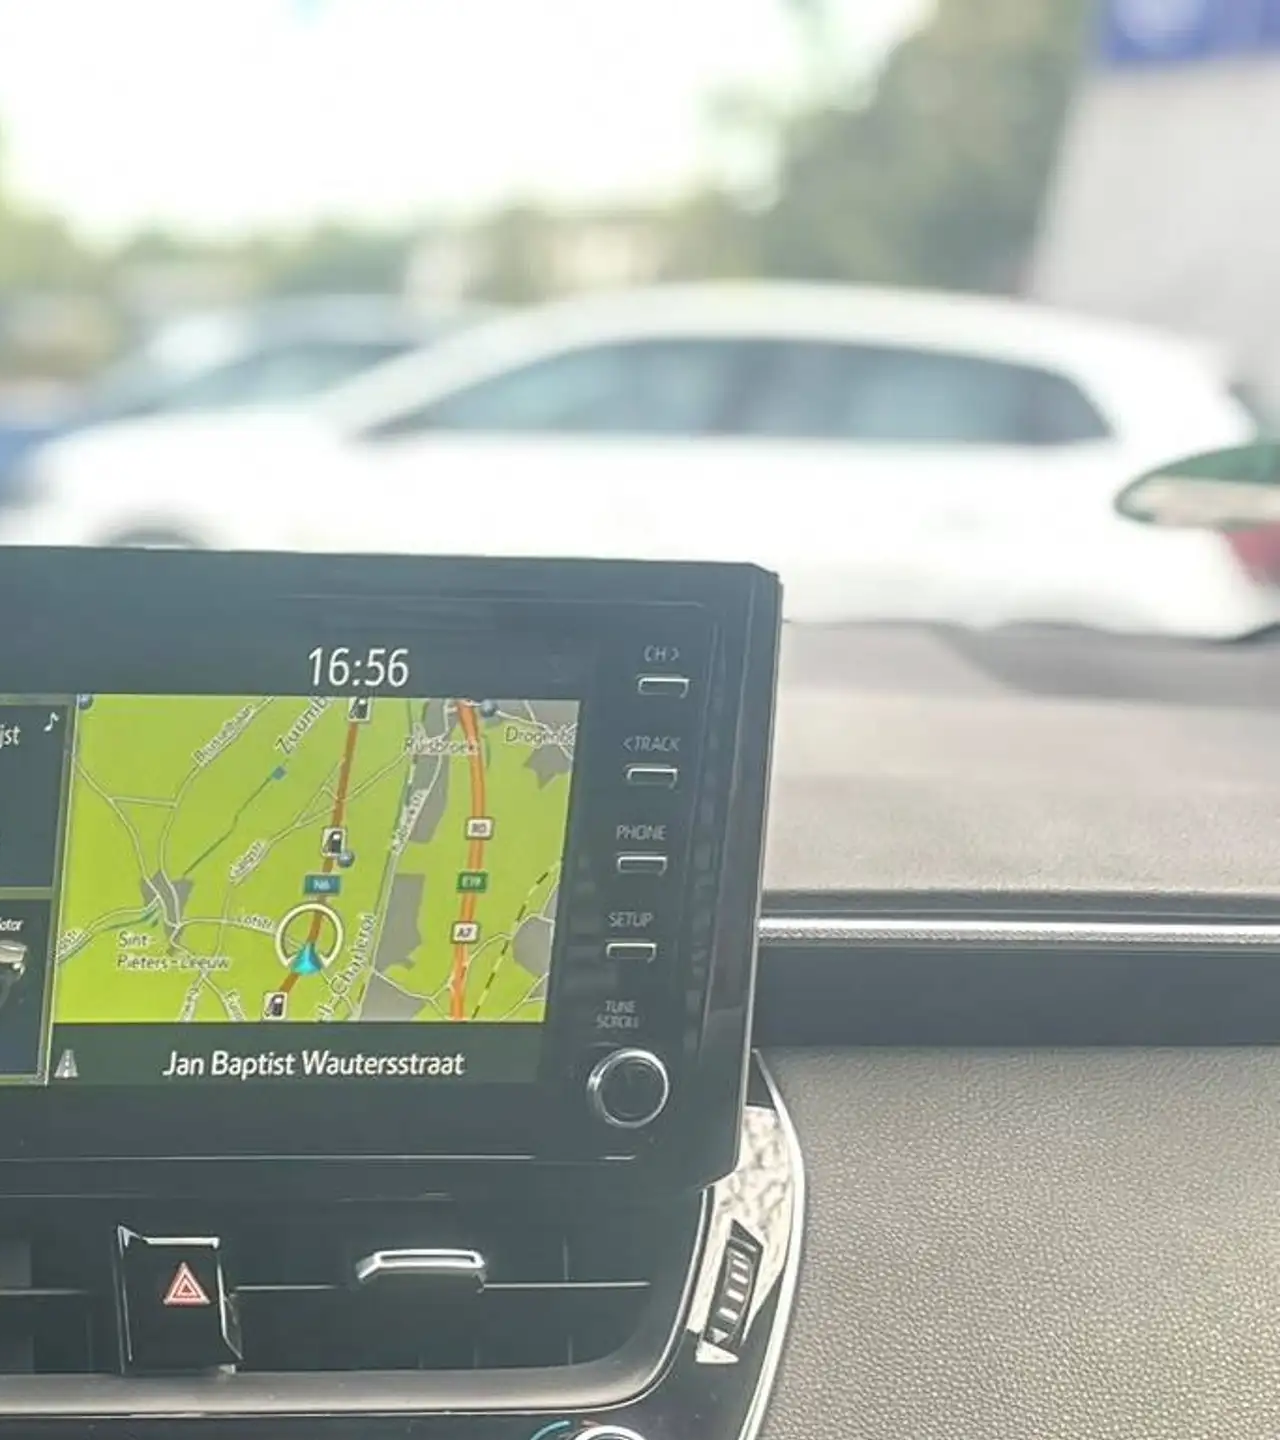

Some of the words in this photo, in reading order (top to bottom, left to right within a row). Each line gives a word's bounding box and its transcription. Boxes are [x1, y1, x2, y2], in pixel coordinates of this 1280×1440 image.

[308, 646, 410, 688] 16:56
[615, 824, 668, 842] PHONE
[608, 912, 654, 929] SETUP
[162, 1050, 204, 1077] Jan
[210, 1049, 296, 1081] Baptist
[301, 1049, 466, 1078] Wautersstraat
